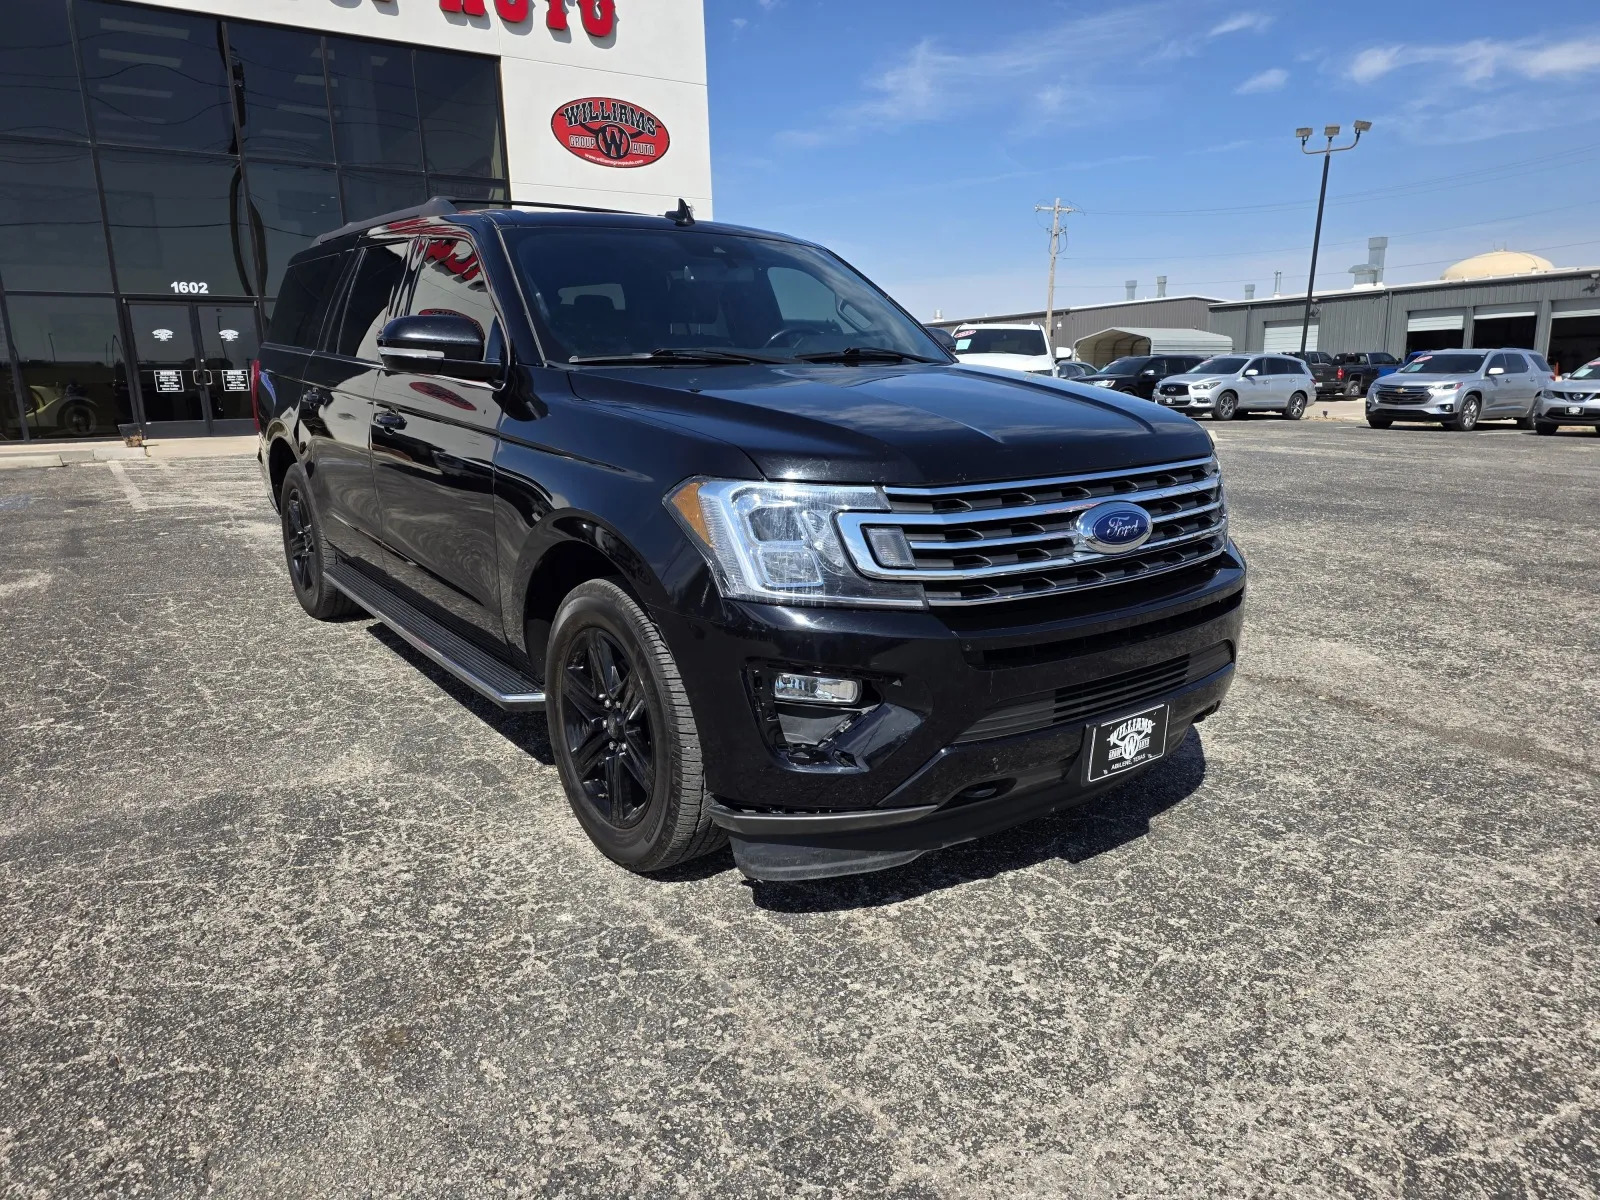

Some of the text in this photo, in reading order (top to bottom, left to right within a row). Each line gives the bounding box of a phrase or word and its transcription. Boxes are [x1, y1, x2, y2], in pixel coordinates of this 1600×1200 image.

[563, 101, 657, 137] WILLIAMS
[569, 135, 597, 149] GROUP
[600, 126, 626, 157] W
[632, 142, 656, 156] AUTO
[170, 281, 209, 294] 1602
[1106, 516, 1140, 539] Ford
[1110, 718, 1152, 746] WILLIAMS
